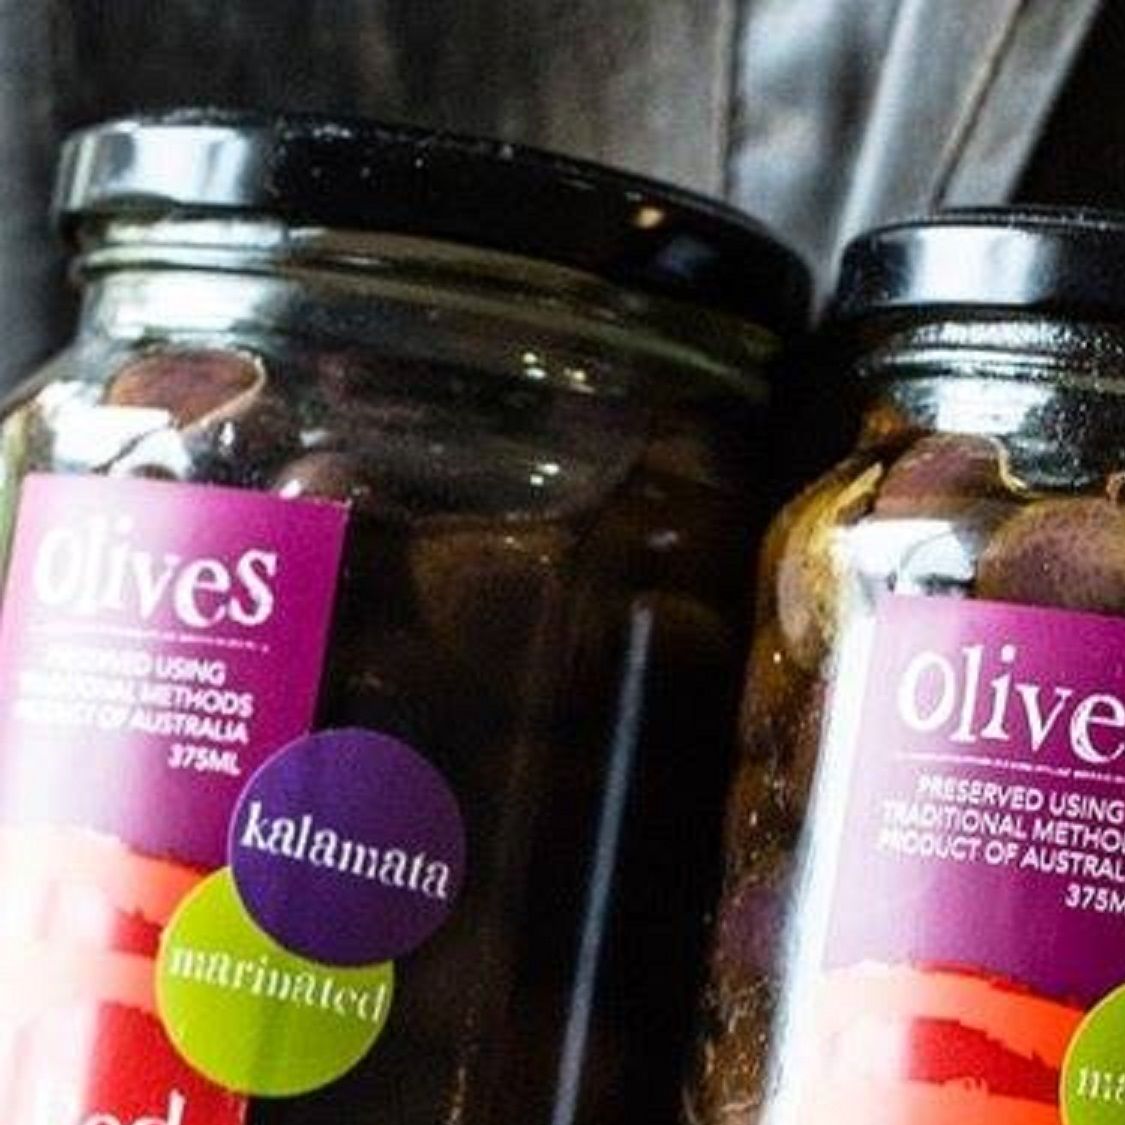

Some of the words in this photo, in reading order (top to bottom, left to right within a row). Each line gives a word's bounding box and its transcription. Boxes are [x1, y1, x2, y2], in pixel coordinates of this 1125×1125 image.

[31, 514, 279, 628] olives
[155, 655, 227, 685] USING
[139, 683, 255, 719] METHODS
[130, 708, 250, 745] AUSTRALIA
[167, 743, 241, 776] 375ML
[916, 772, 1044, 812] PRESERVED
[1048, 791, 1125, 825] USING
[881, 799, 1027, 840] TRADITIONAL
[239, 801, 451, 898] kalamata
[877, 828, 981, 861] PRODUCT
[983, 840, 1019, 866] OF
[168, 943, 387, 1025] marinated
